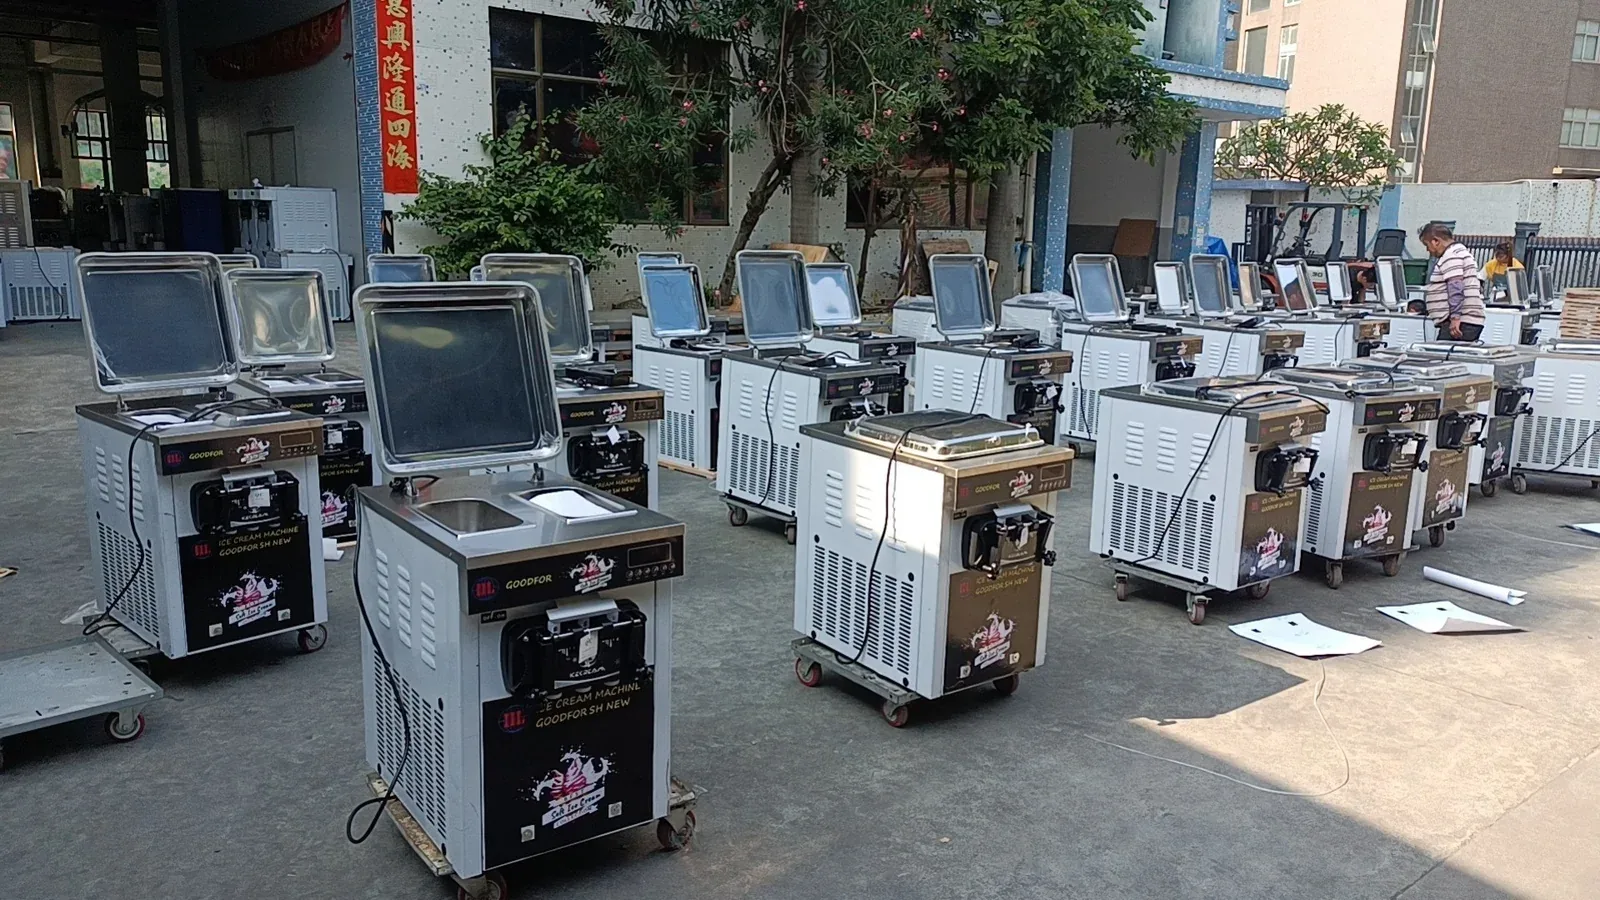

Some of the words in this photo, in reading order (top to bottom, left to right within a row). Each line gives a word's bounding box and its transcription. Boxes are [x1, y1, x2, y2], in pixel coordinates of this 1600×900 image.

[189, 450, 224, 460] GOODFOR
[219, 537, 231, 546] ICE
[233, 533, 262, 544] CREAM
[263, 526, 299, 538] MACHINE
[219, 544, 258, 557] GOODFOR
[259, 541, 271, 549] SH
[272, 537, 292, 546] NEW
[505, 574, 553, 590] GOODFOR
[1013, 577, 1029, 586] NEW
[555, 692, 593, 709] CREAM
[594, 682, 641, 699] MACHINE
[535, 709, 587, 728] GOODFOR
[588, 703, 604, 715] SH
[605, 697, 631, 711] NEW
[551, 808, 565, 820] Soft
[580, 793, 602, 806] Cream
